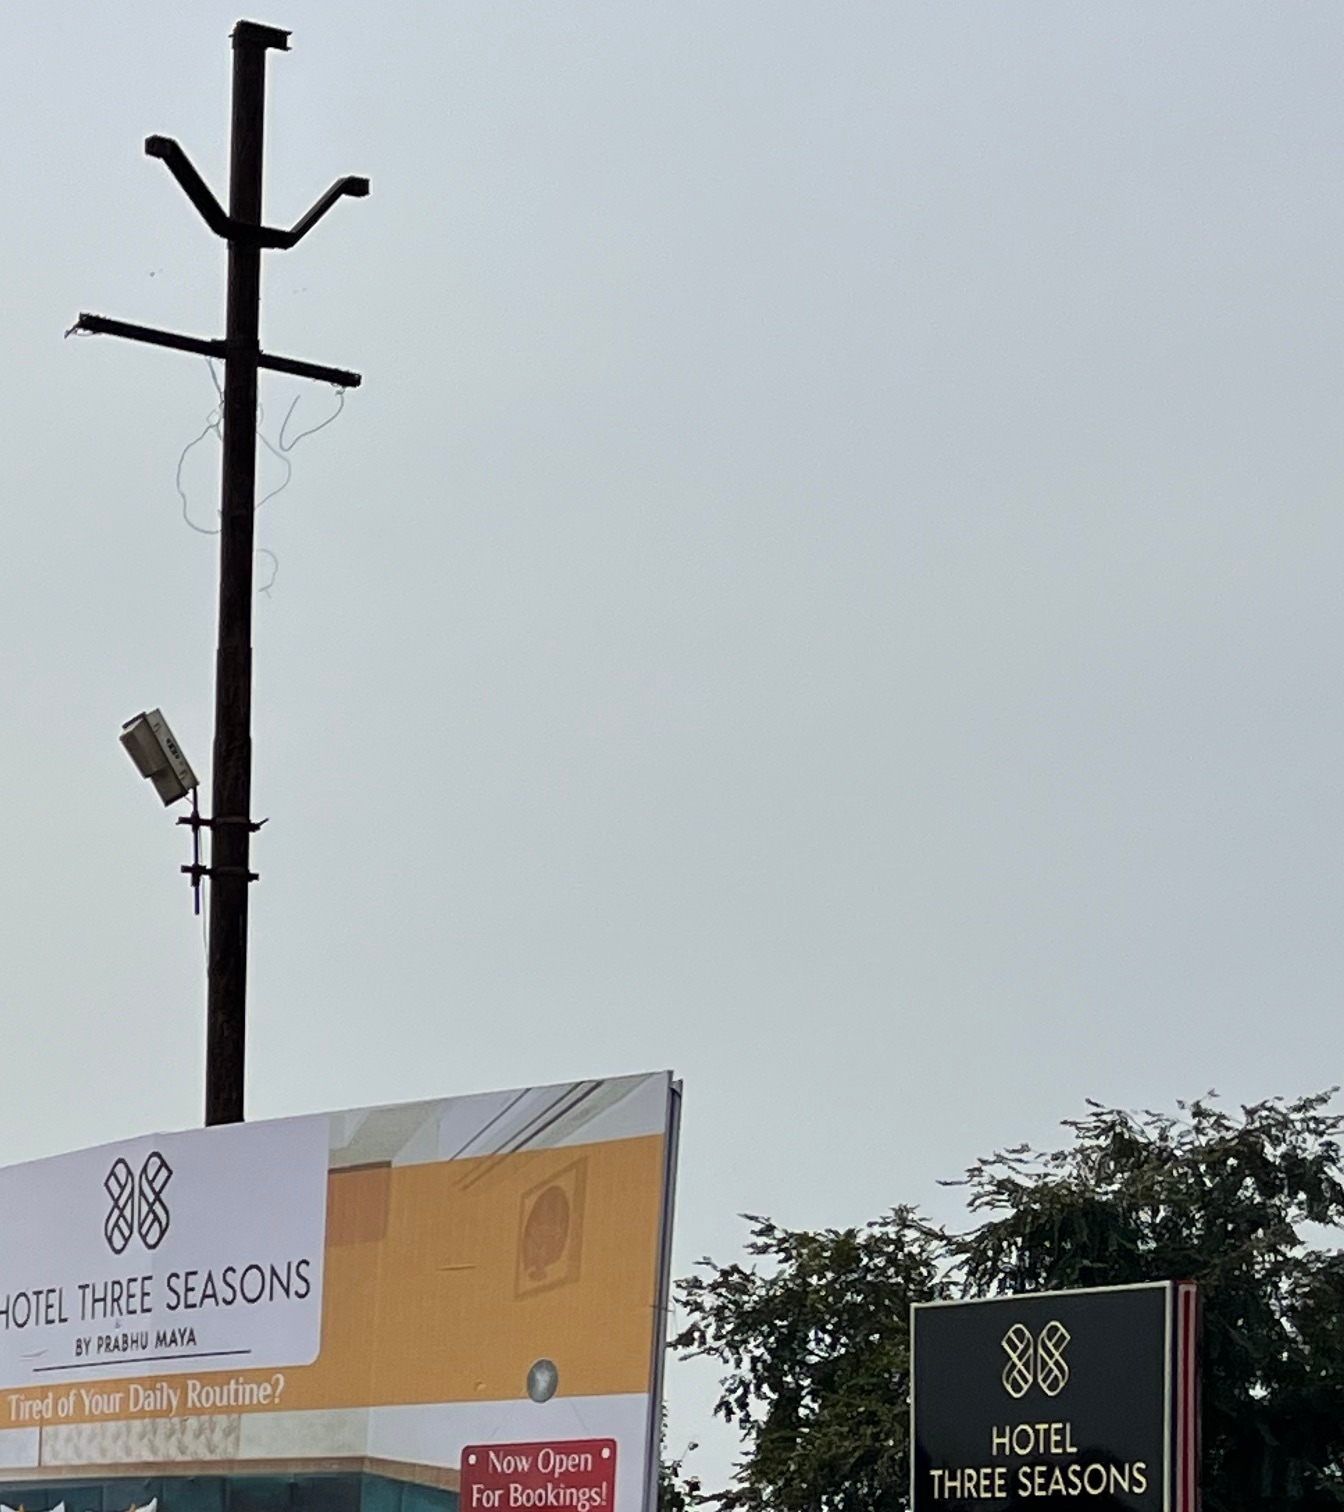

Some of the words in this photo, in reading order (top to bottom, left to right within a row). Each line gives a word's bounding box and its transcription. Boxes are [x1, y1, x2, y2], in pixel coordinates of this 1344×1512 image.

[78, 1275, 154, 1321] THREE
[165, 1258, 311, 1311] SEASONS
[75, 1338, 92, 1356] BY
[97, 1331, 149, 1353] PRABHU
[155, 1327, 197, 1349] MAYA
[8, 1392, 54, 1422] Tired
[57, 1390, 79, 1418] of
[80, 1387, 125, 1415] Your
[128, 1380, 181, 1416] Daily
[186, 1373, 285, 1408] Routine?
[992, 1422, 1078, 1456] HOTEL
[488, 1450, 533, 1475] Now
[537, 1448, 592, 1478] Open
[929, 1467, 1007, 1499] THREE
[1018, 1461, 1148, 1497] SEASONS
[471, 1484, 504, 1508] For
[509, 1481, 608, 1512] Bookings!
